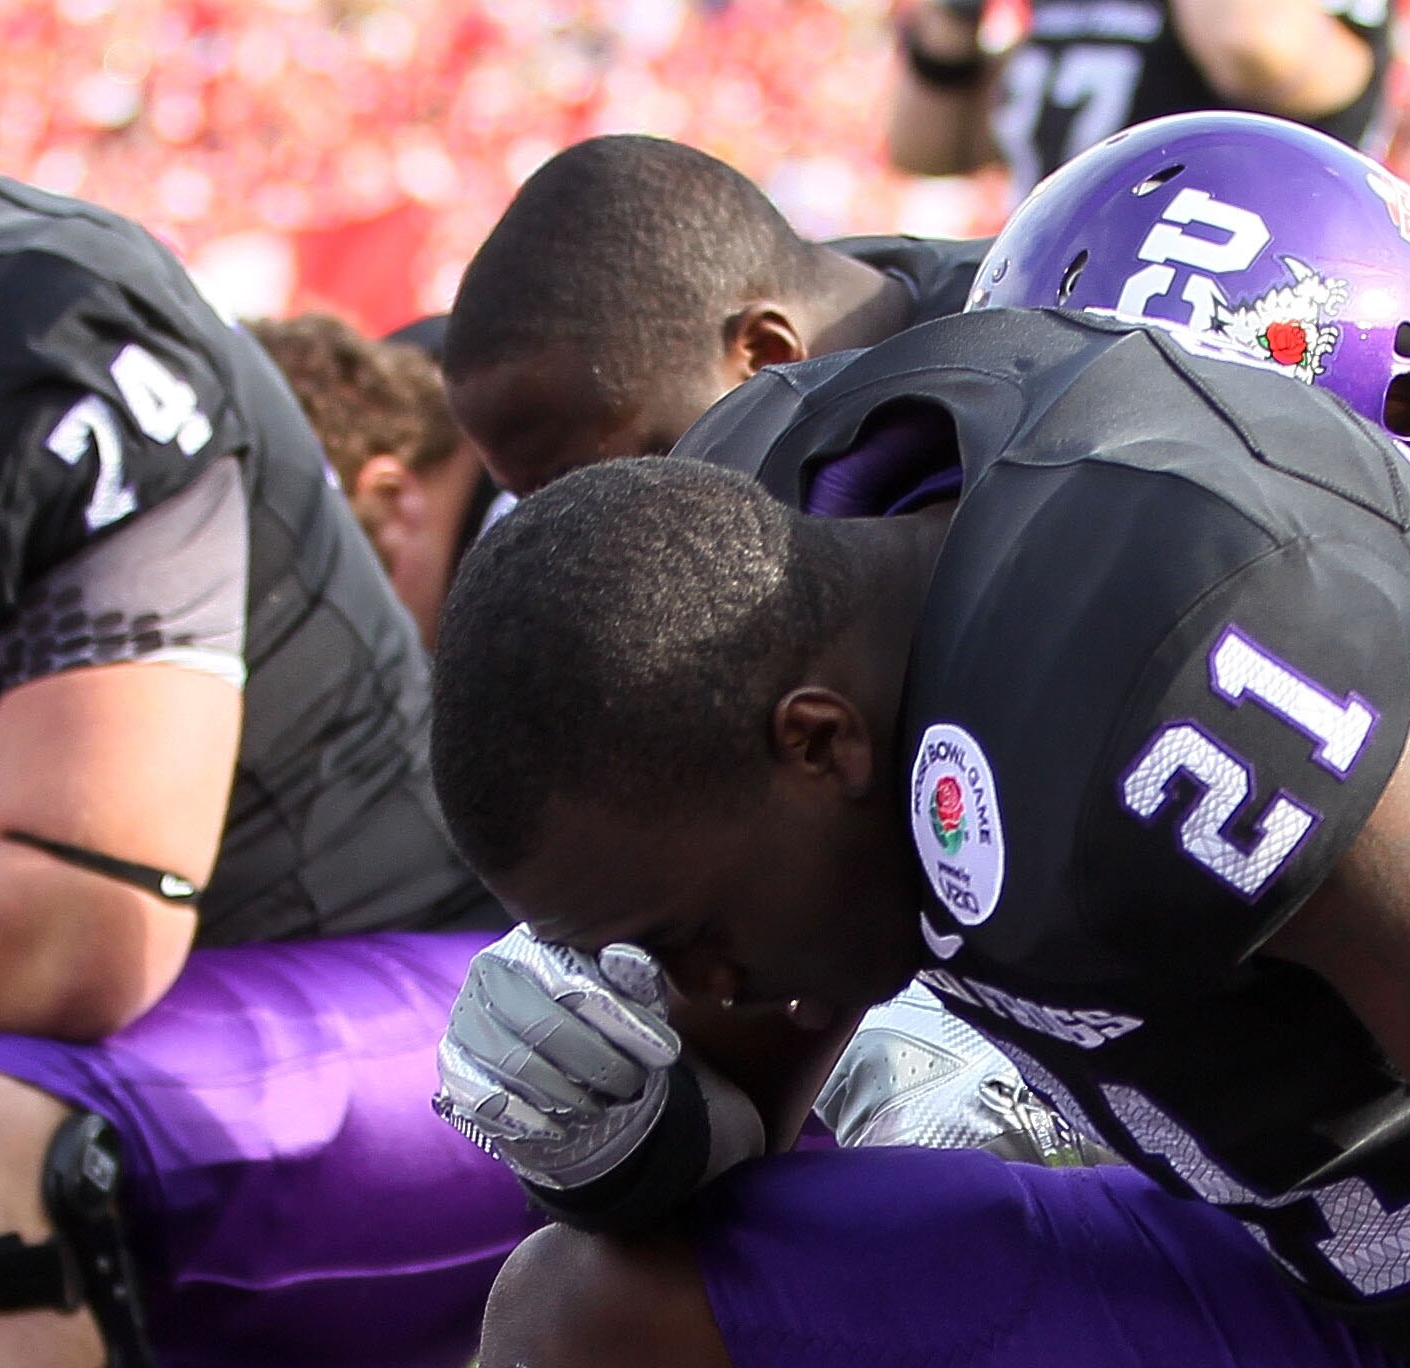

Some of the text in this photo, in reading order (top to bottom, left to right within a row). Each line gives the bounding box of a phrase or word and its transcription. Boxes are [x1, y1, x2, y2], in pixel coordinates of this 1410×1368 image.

[1115, 187, 1273, 334] CU
[44, 342, 214, 531] 74
[928, 740, 967, 773] BOWL
[967, 766, 992, 846] GAME
[1119, 623, 1380, 898] 21
